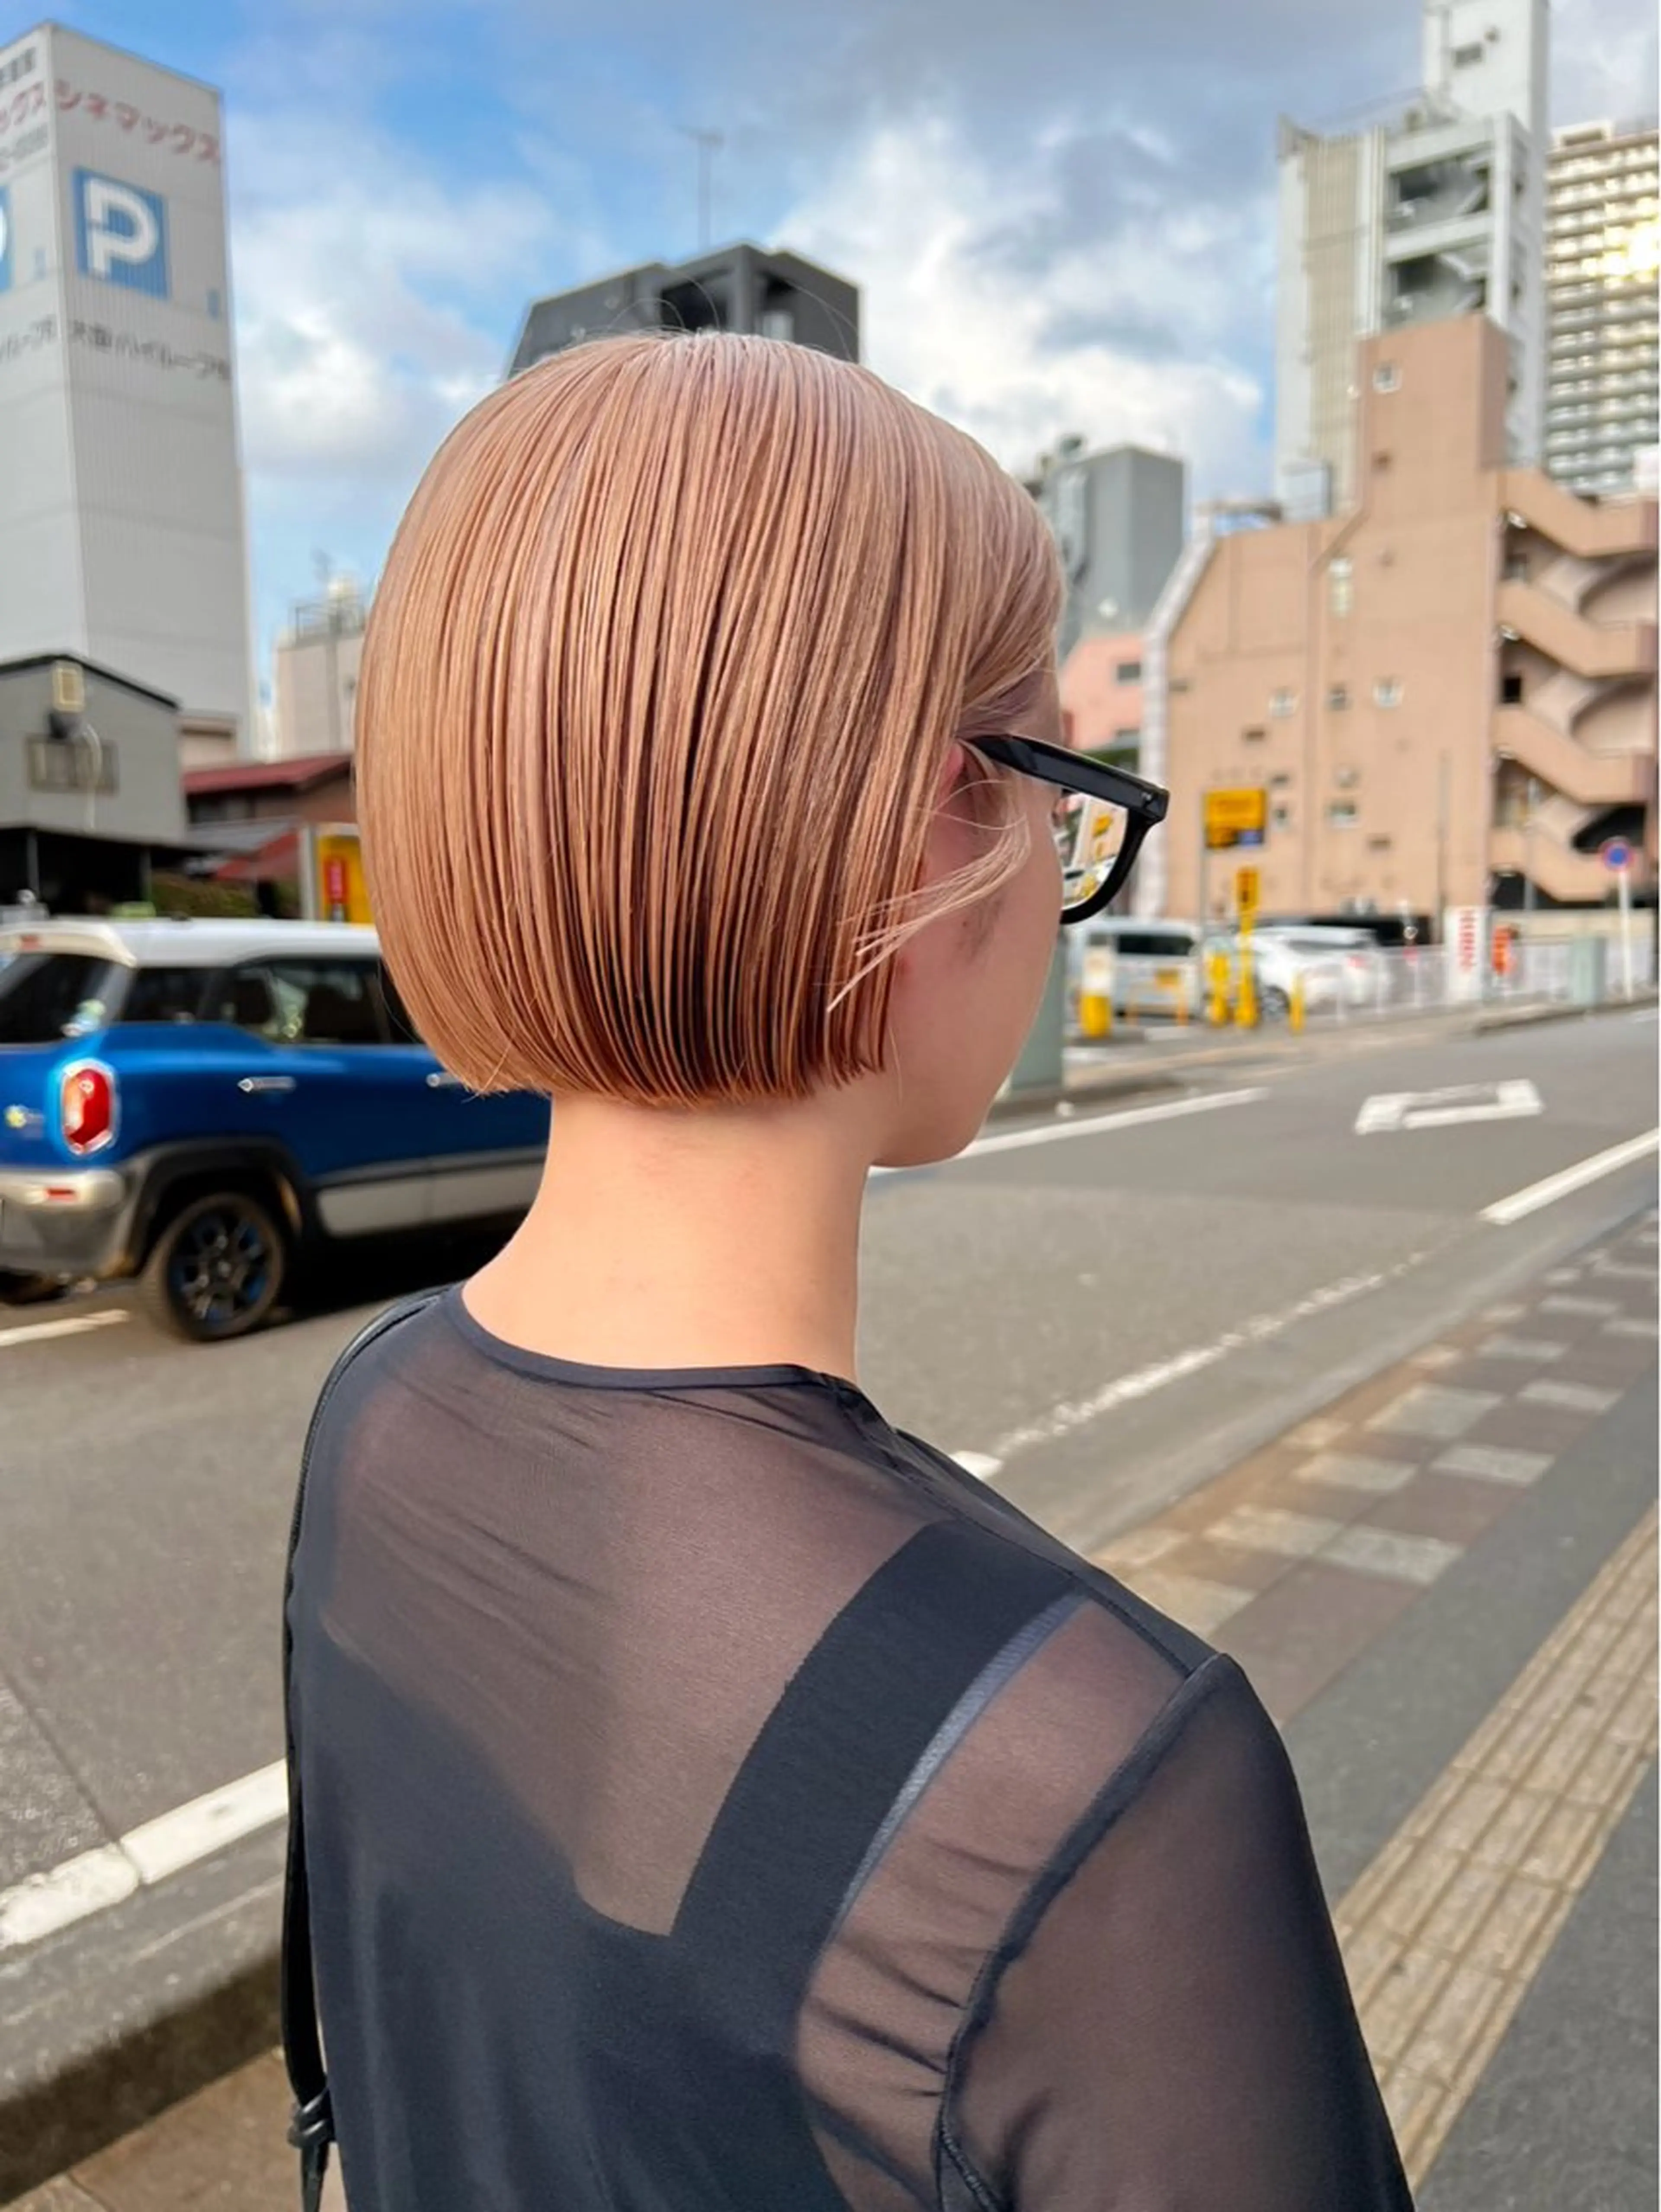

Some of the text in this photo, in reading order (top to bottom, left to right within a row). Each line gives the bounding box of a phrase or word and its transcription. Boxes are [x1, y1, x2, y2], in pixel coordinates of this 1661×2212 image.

[54, 79, 220, 164] シネマックス
[85, 176, 158, 279] P
